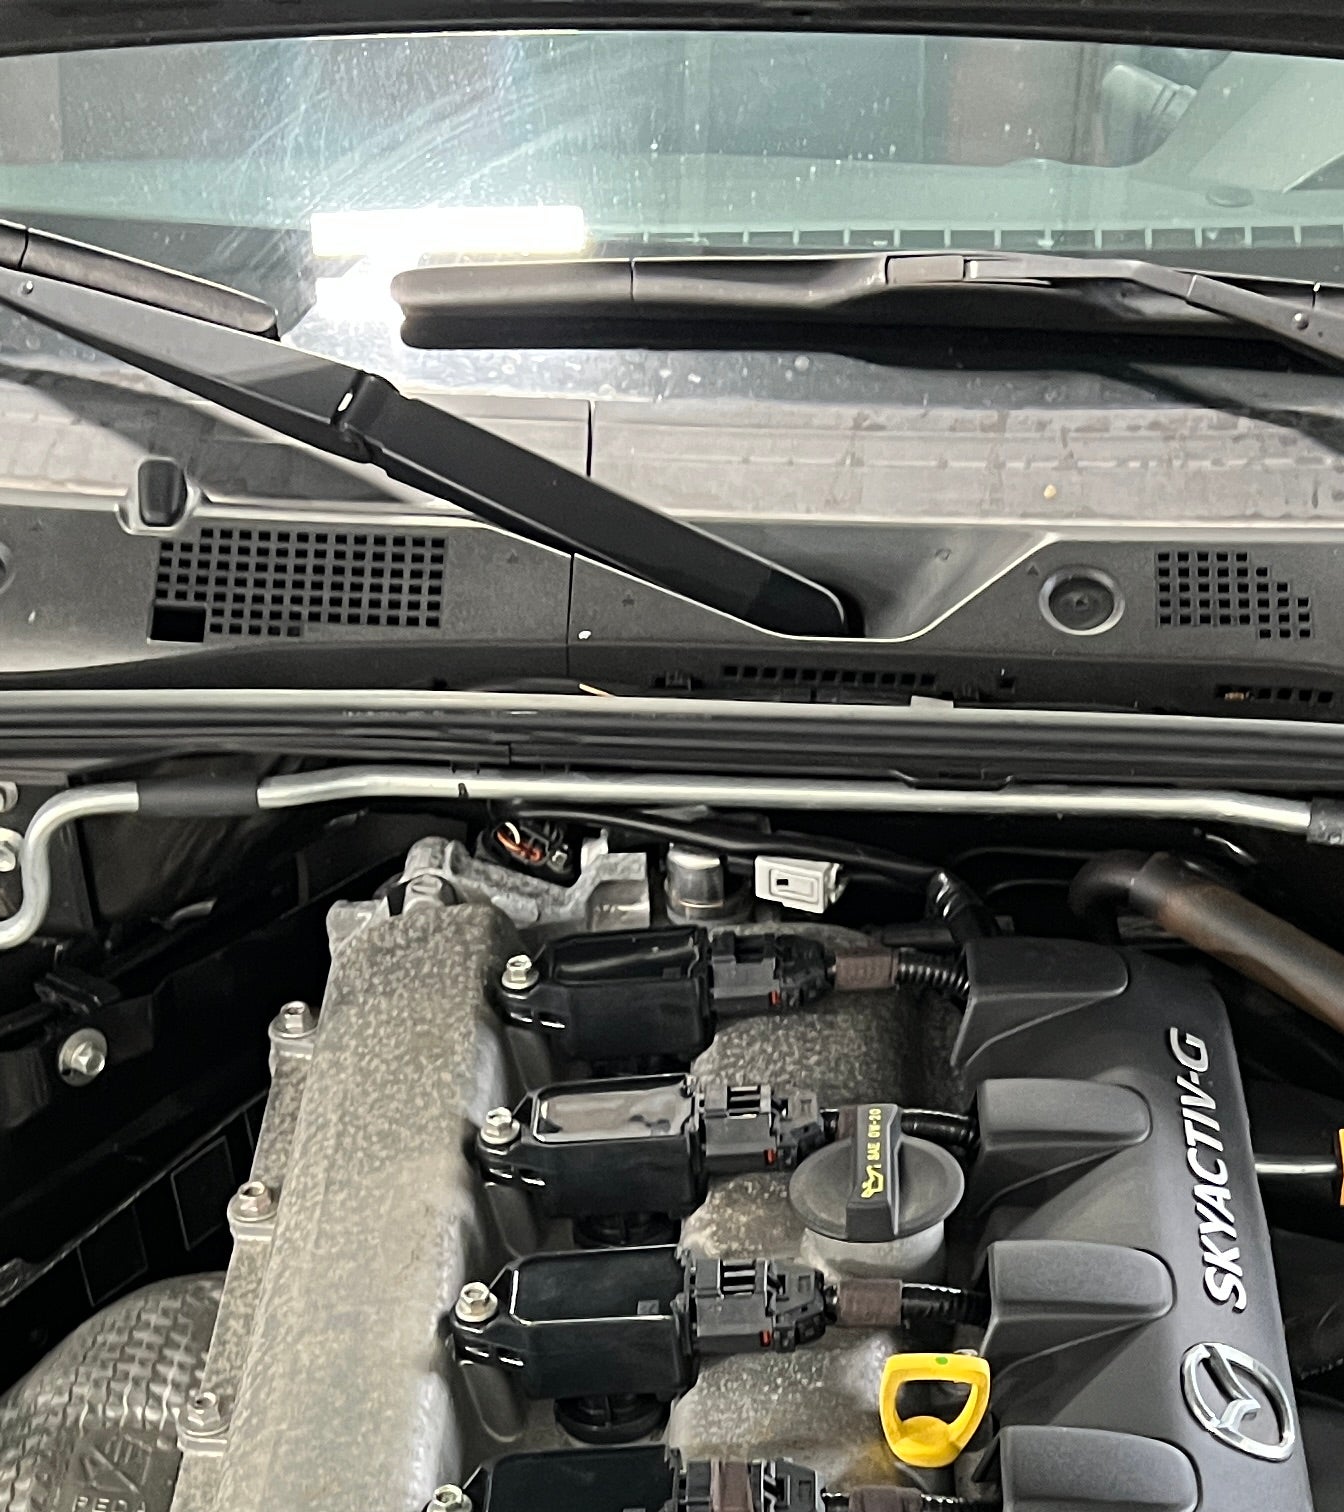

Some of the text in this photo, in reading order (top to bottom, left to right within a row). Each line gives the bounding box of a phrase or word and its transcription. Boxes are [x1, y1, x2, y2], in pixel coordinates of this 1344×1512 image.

[867, 1109, 882, 1161] SAE 0W-20
[1170, 1027, 1247, 1312] SKYACTIV-G
